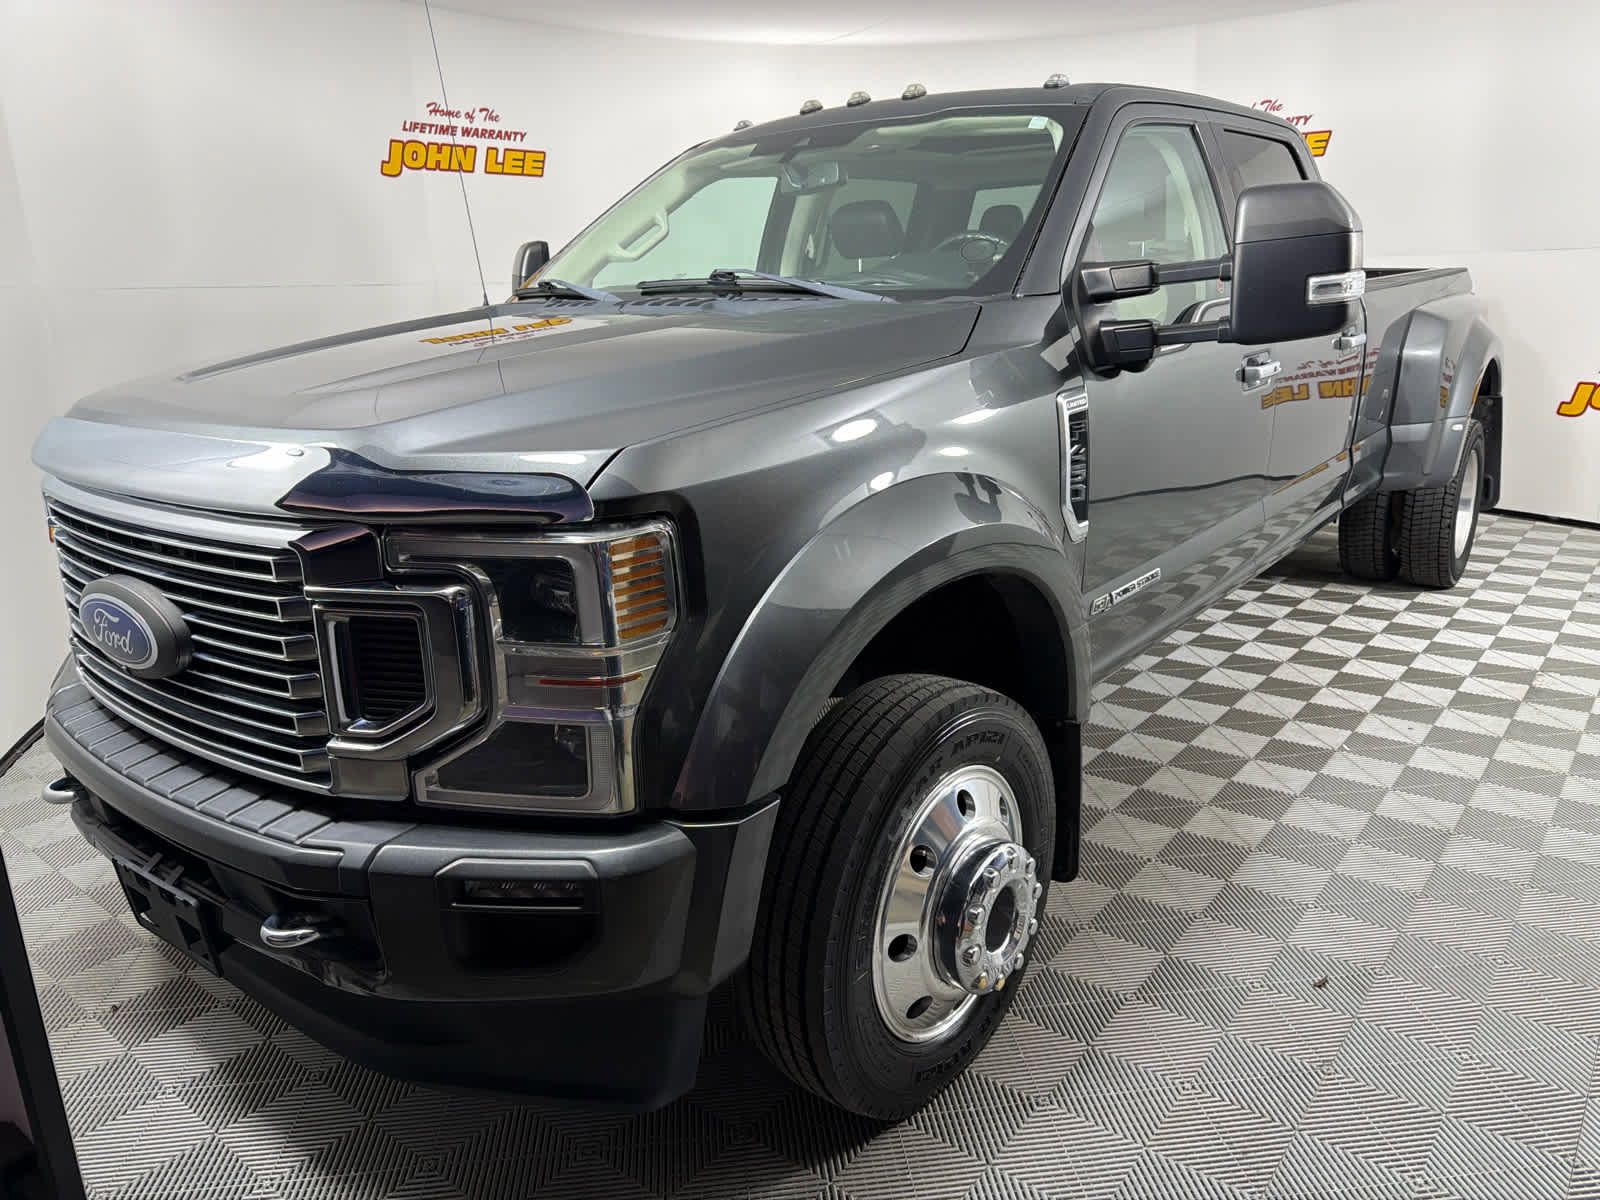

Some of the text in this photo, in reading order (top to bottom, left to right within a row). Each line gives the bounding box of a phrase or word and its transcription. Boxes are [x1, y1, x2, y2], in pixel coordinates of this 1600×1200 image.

[426, 102, 500, 123] Home of The
[402, 120, 527, 142] LIFETIME WARRANTY
[380, 138, 546, 178] JOHN LEE
[93, 608, 133, 655] Ford
